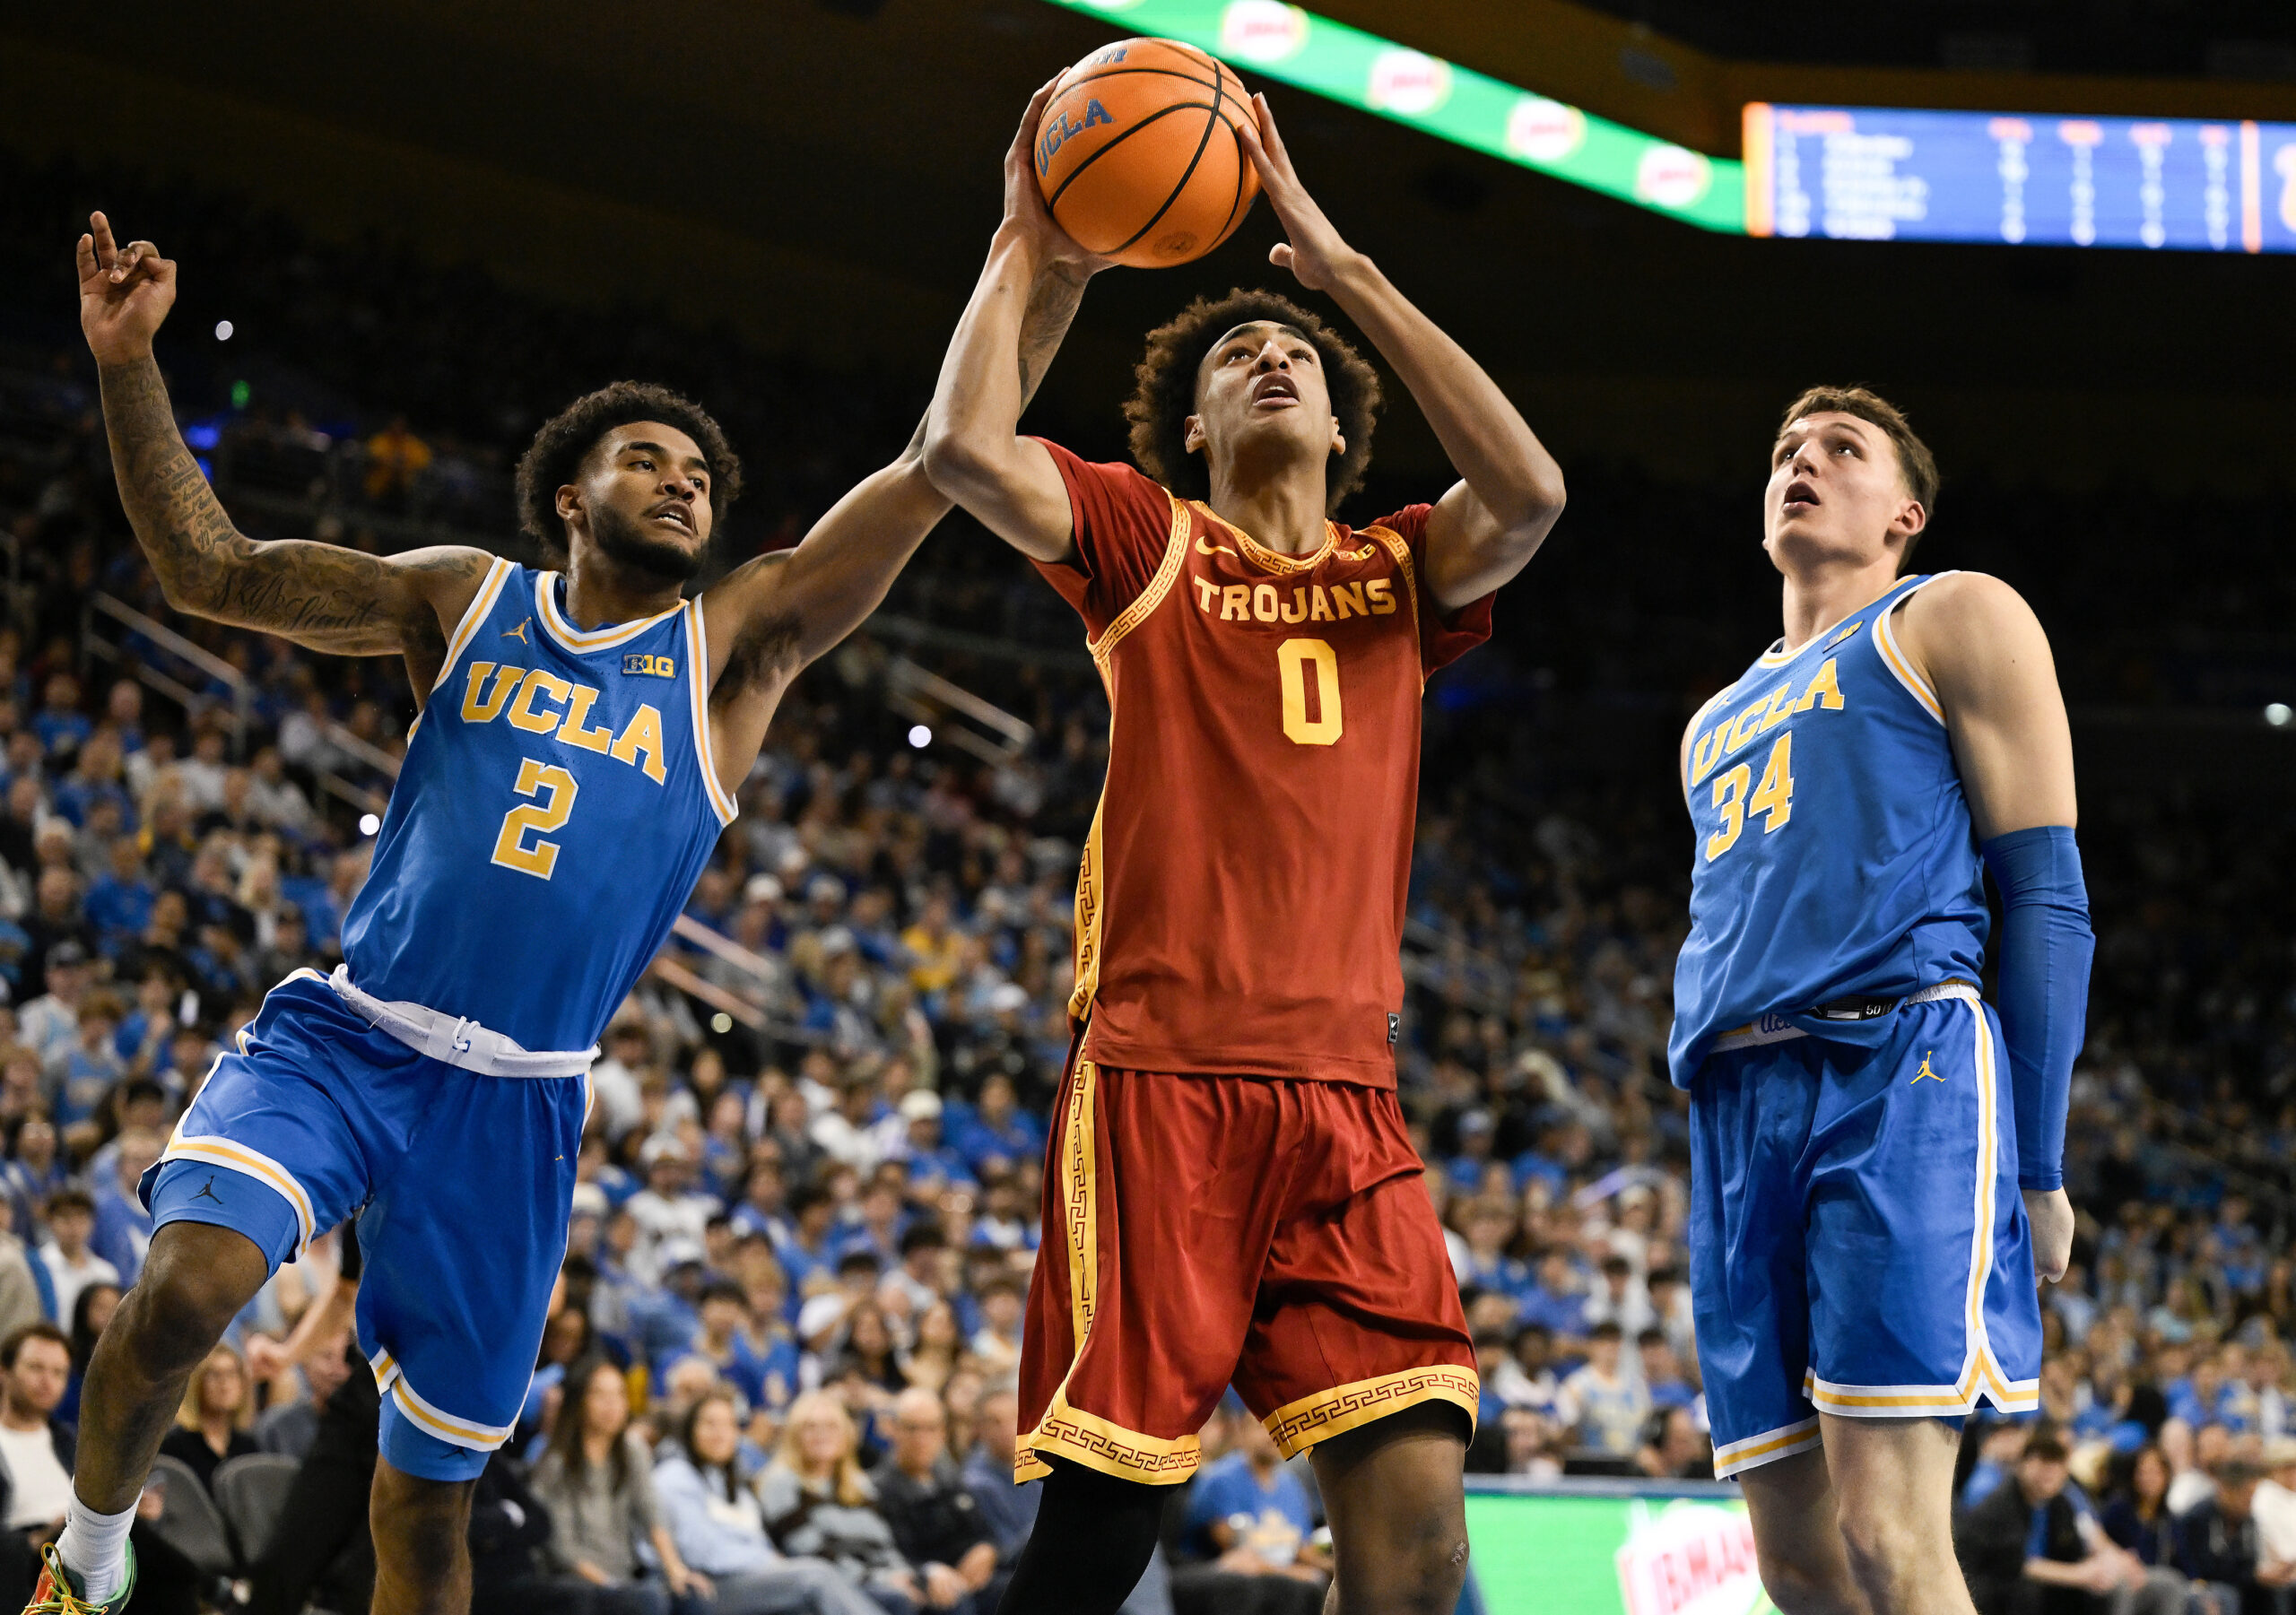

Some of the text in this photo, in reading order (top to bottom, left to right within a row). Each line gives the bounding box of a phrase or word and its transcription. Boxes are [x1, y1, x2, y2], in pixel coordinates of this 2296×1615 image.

[1037, 99, 1114, 178] UCLA
[1194, 575, 1396, 624] TROJANS
[460, 662, 667, 786] UCLA
[1277, 638, 1343, 745] 0
[1692, 657, 1845, 787] UCLA
[491, 757, 579, 881] 2
[1705, 730, 1794, 863] 34
